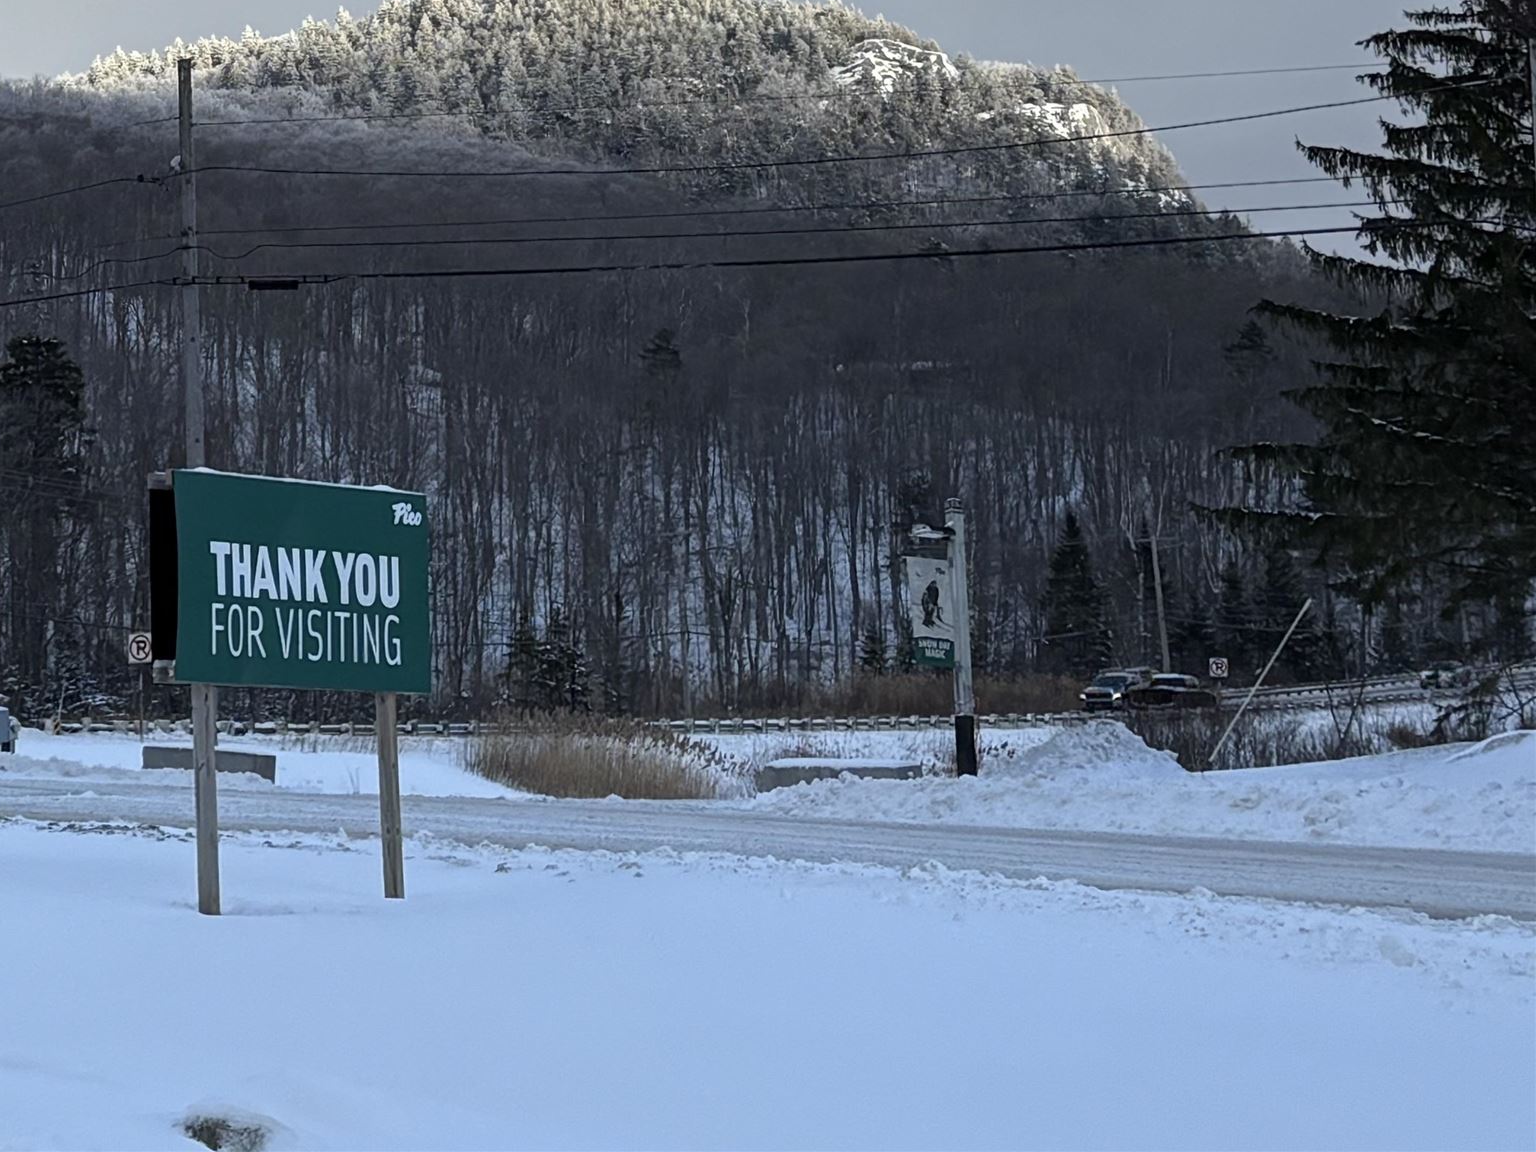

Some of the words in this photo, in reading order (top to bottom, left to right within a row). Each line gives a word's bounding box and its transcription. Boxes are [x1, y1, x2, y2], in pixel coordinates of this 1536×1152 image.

[392, 502, 422, 526] Pico
[210, 541, 328, 604] THANK
[332, 551, 400, 608] YOU
[212, 603, 266, 658] FOR
[275, 607, 402, 665] VISITING
